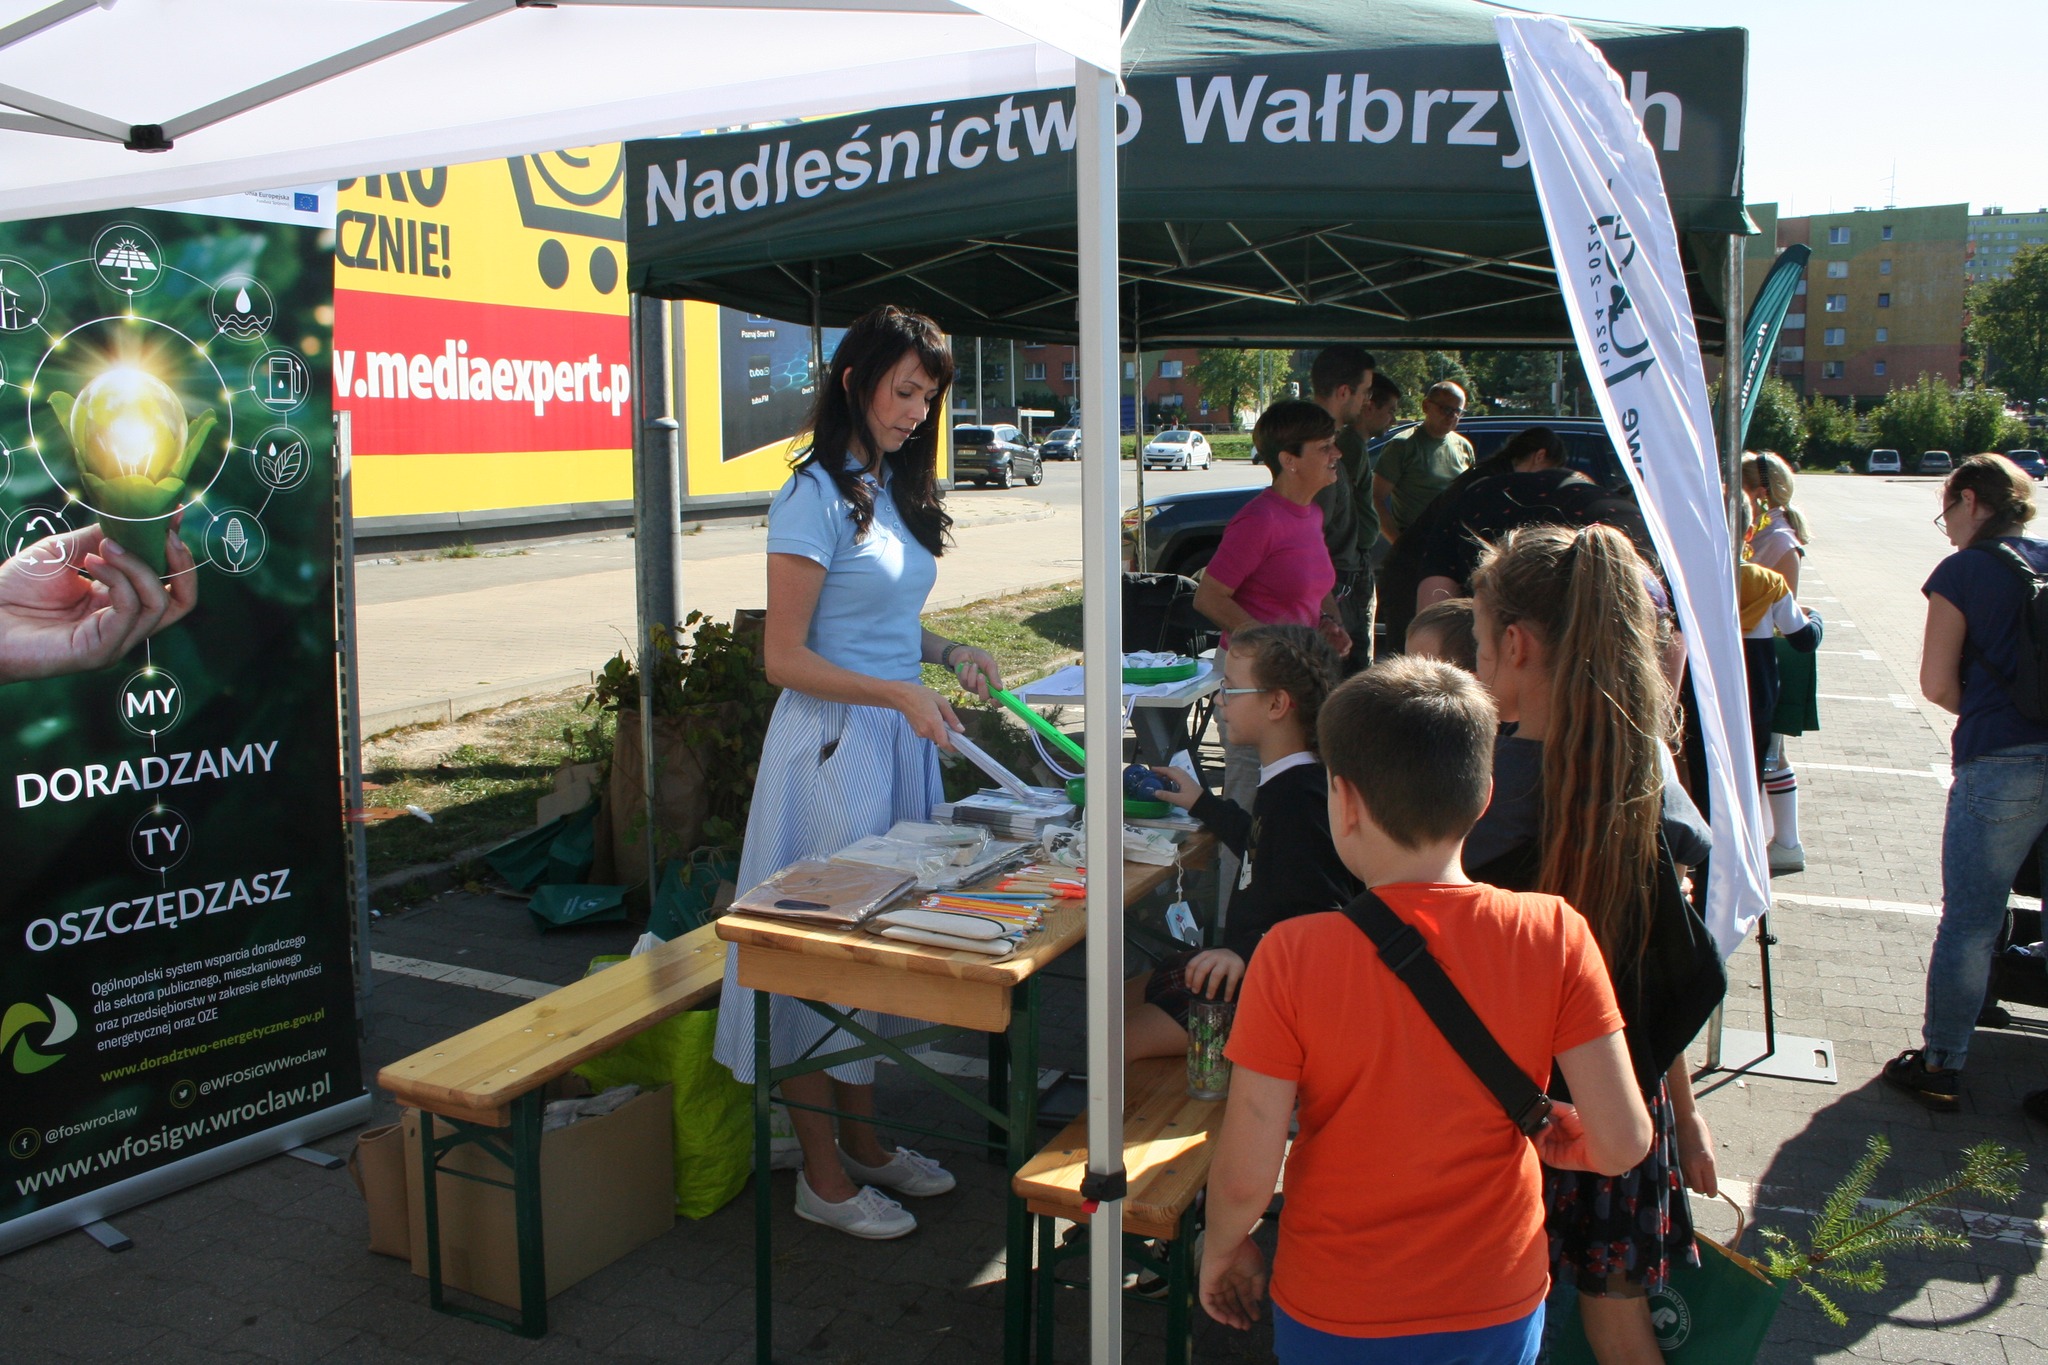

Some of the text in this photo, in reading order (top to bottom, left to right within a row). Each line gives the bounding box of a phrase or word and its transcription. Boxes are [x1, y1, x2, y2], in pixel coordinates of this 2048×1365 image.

[1175, 71, 1682, 168] Wałbrzyh
[336, 209, 451, 279] CZNIE!
[126, 687, 176, 718] MY
[16, 740, 279, 809] DORADZAMY
[139, 824, 182, 855] TY
[25, 868, 292, 952] OSZCZĘDZASZ
[91, 935, 306, 997] Ogólnopolski system wsparcia doradczego
[93, 953, 302, 1014] dla sektora publicznego, mieszkaniowego
[95, 962, 322, 1034] oraz przedsiębiorstw w zakresie efektywności
[97, 1007, 219, 1052] energetycznej oraz OZE
[100, 1007, 325, 1082] www.doradztwo-energetyczne.gov.pl
[199, 1047, 327, 1095] @WFOSiGWWroclaw
[16, 1072, 332, 1196] www.wfosigw.wroclaw.pl
[45, 1104, 138, 1144] @foswroclaw
